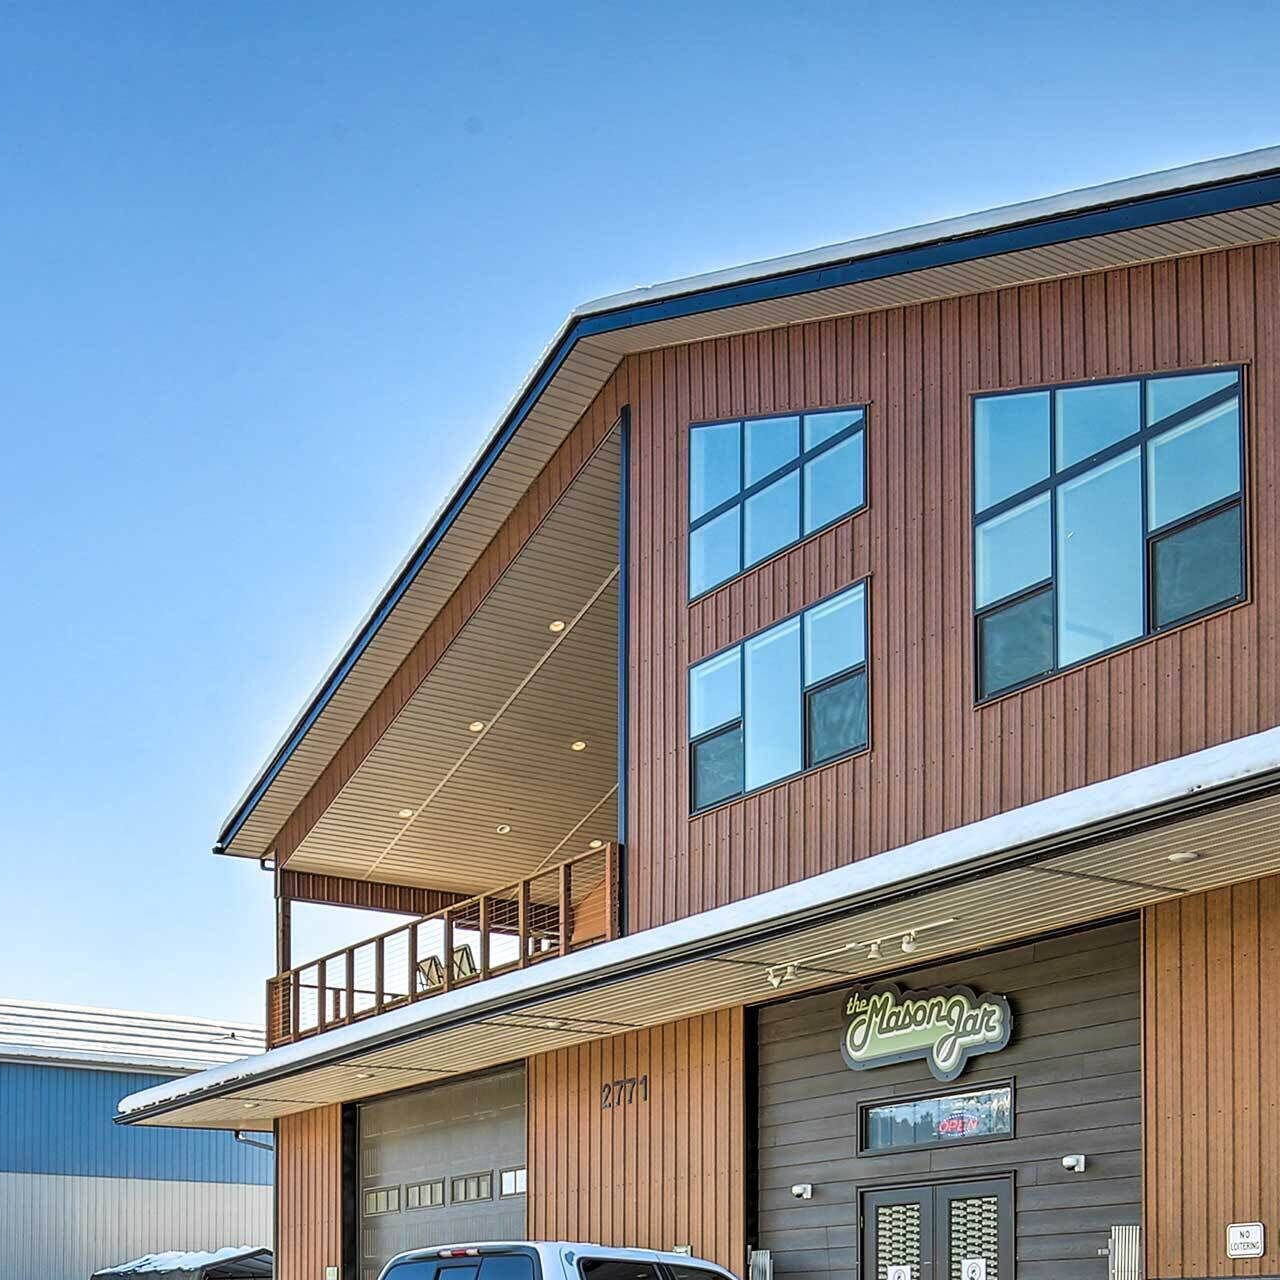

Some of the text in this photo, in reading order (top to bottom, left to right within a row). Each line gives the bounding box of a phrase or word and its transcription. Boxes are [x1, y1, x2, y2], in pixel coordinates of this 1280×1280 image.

[846, 992, 998, 1063] the Mason Jar
[601, 1074, 648, 1109] 2771
[938, 1119, 978, 1133] OPEN
[1239, 1230, 1251, 1239] NO
[1230, 1241, 1260, 1251] LOITERING
